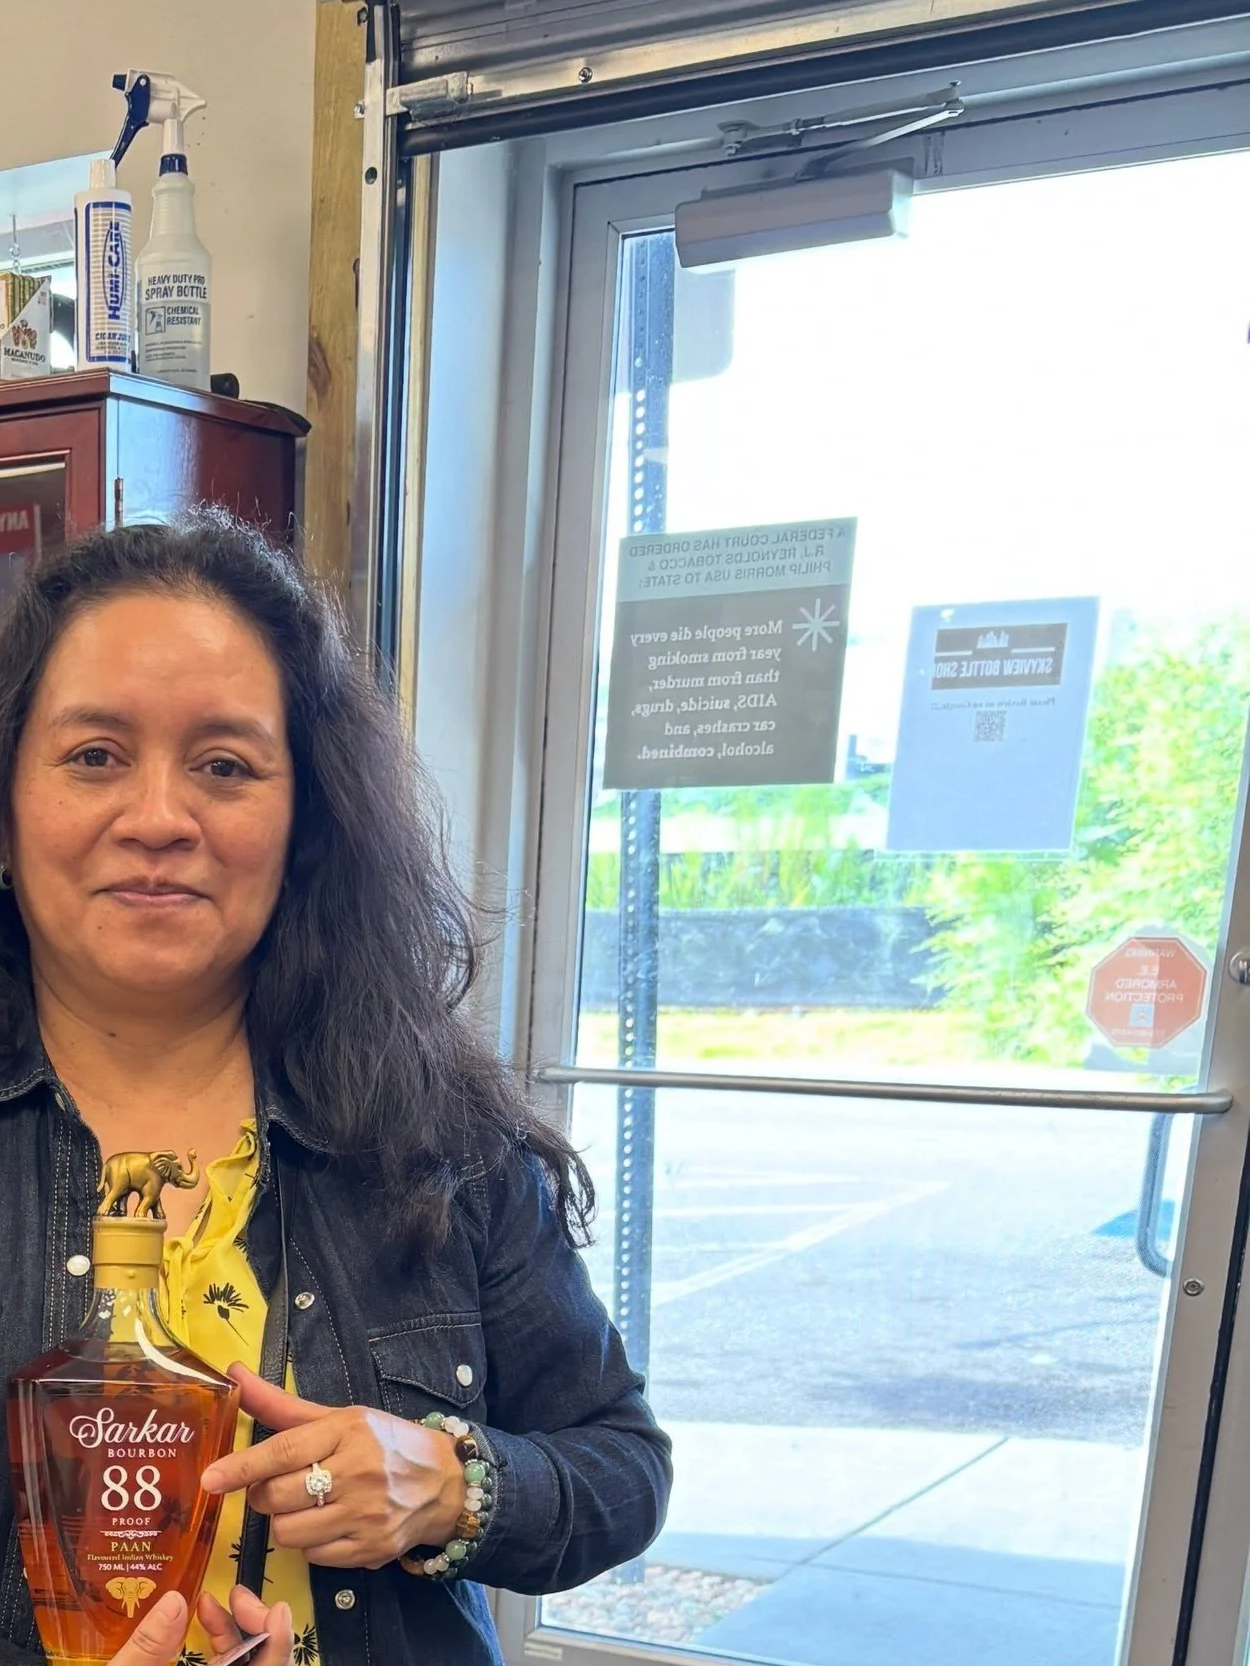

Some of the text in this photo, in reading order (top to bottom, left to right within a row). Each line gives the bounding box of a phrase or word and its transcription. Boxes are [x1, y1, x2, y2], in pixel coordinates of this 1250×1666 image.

[147, 273, 206, 286] HEAVY DUTY PRO
[145, 285, 207, 301] SPRAY BOTTLE
[166, 306, 200, 316] CHEMICAL
[166, 316, 202, 326] RESISTANT
[3, 347, 46, 363] MACANUDO
[69, 1406, 196, 1449] Sarkar
[107, 1448, 177, 1459] BOURBON
[101, 1464, 163, 1512] 88
[111, 1517, 152, 1526] PROOF
[110, 1541, 152, 1552] PAAN
[87, 1553, 174, 1562] Flavoured Indian Whiskey
[98, 1563, 112, 1571] 750
[113, 1563, 125, 1571] ML
[147, 1563, 163, 1571] ALC
